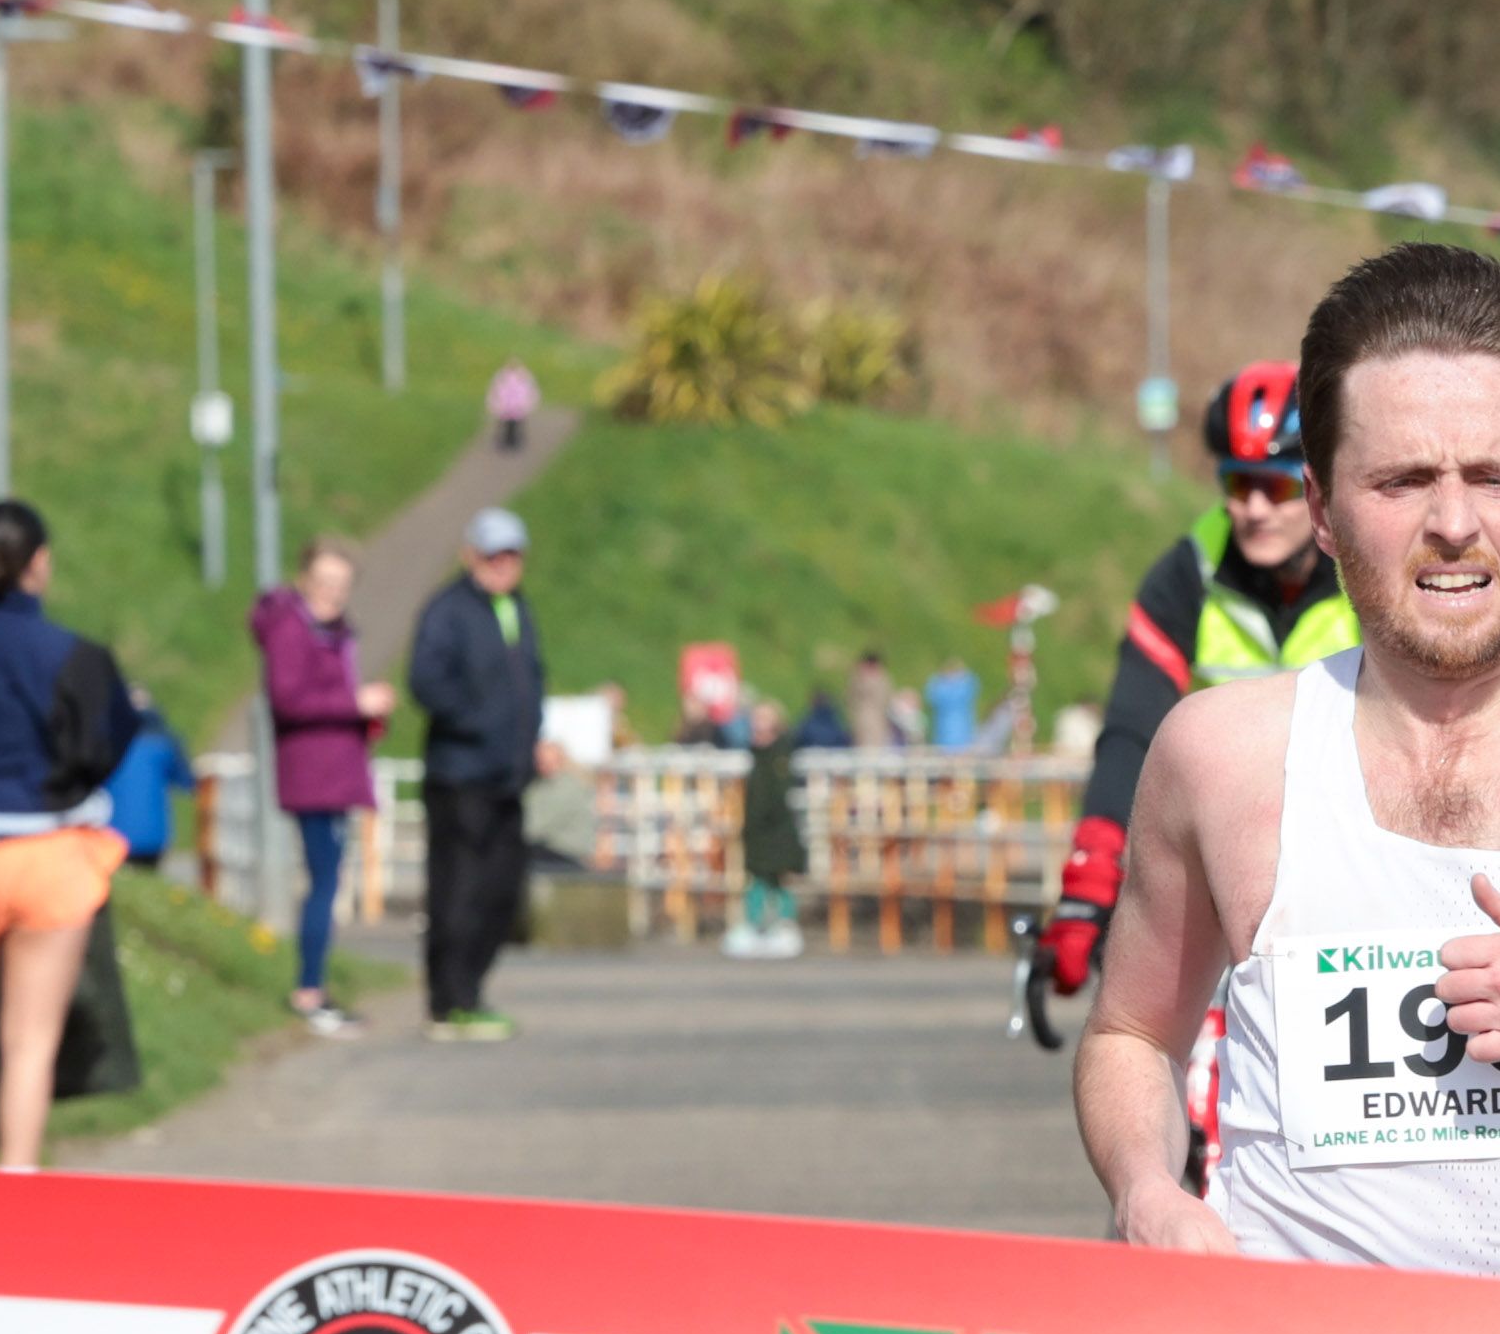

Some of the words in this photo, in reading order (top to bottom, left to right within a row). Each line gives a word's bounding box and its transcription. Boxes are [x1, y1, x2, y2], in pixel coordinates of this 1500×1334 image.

[1313, 1130, 1368, 1148] LARNE
[1374, 1128, 1398, 1144] AC
[1404, 1127, 1426, 1142] 10
[1432, 1127, 1469, 1141] Mile
[313, 1266, 467, 1334] ATHLETIC
